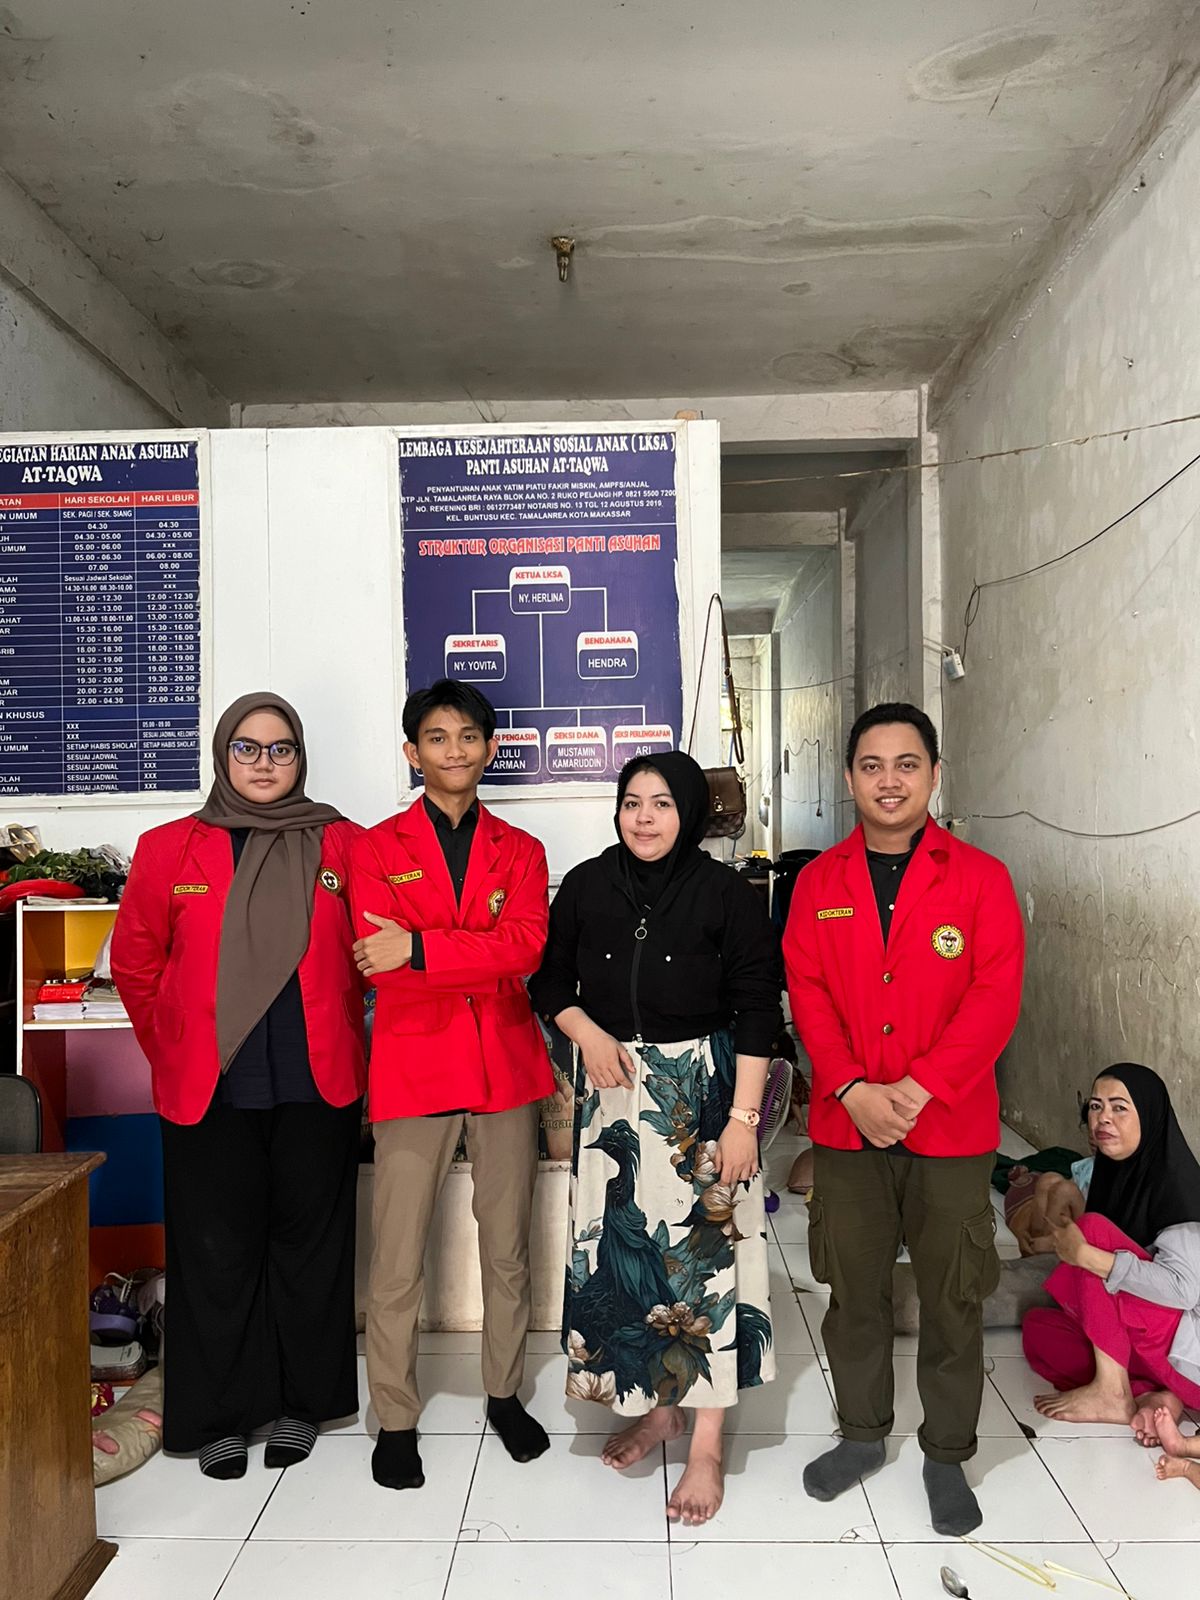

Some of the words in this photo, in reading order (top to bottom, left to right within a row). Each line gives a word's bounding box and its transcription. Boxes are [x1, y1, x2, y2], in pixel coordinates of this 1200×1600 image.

[400, 441, 453, 457] LEMBAGA
[455, 438, 551, 455] KESEJAHTERAAN
[553, 436, 593, 453] SOSIAL
[595, 436, 629, 452] ANAK
[638, 435, 668, 451] LKSA
[50, 445, 97, 461] HARIAN
[100, 443, 136, 460] ANAK
[139, 444, 189, 459] ASUHAN
[466, 459, 500, 475] PANTI
[502, 458, 549, 474] ASUHAN
[552, 456, 609, 475] AT-TAQWA
[22, 465, 103, 485] AT-TAQWA
[166, 494, 194, 502] LIBUR
[579, 491, 612, 499] PELANGI
[590, 510, 631, 518] MAKASSAR
[418, 539, 488, 556] STRUKTUR
[488, 537, 565, 555] ORGANISASI
[566, 536, 606, 553] PANTI
[607, 534, 661, 552] ASUHAN
[519, 594, 530, 603] NY.
[532, 593, 564, 602] HERLINA
[585, 637, 632, 645] BENDAHARA
[454, 662, 466, 670] NY.
[468, 661, 497, 670] YOVITA
[588, 658, 627, 668] HENDRA
[6, 711, 45, 719] KHUSUS
[497, 749, 521, 758] LULU
[558, 747, 596, 757] MUSTAMIN
[635, 746, 652, 755] ARI
[493, 760, 526, 770] ARMAN
[553, 758, 602, 768] KAMARUDDIN
